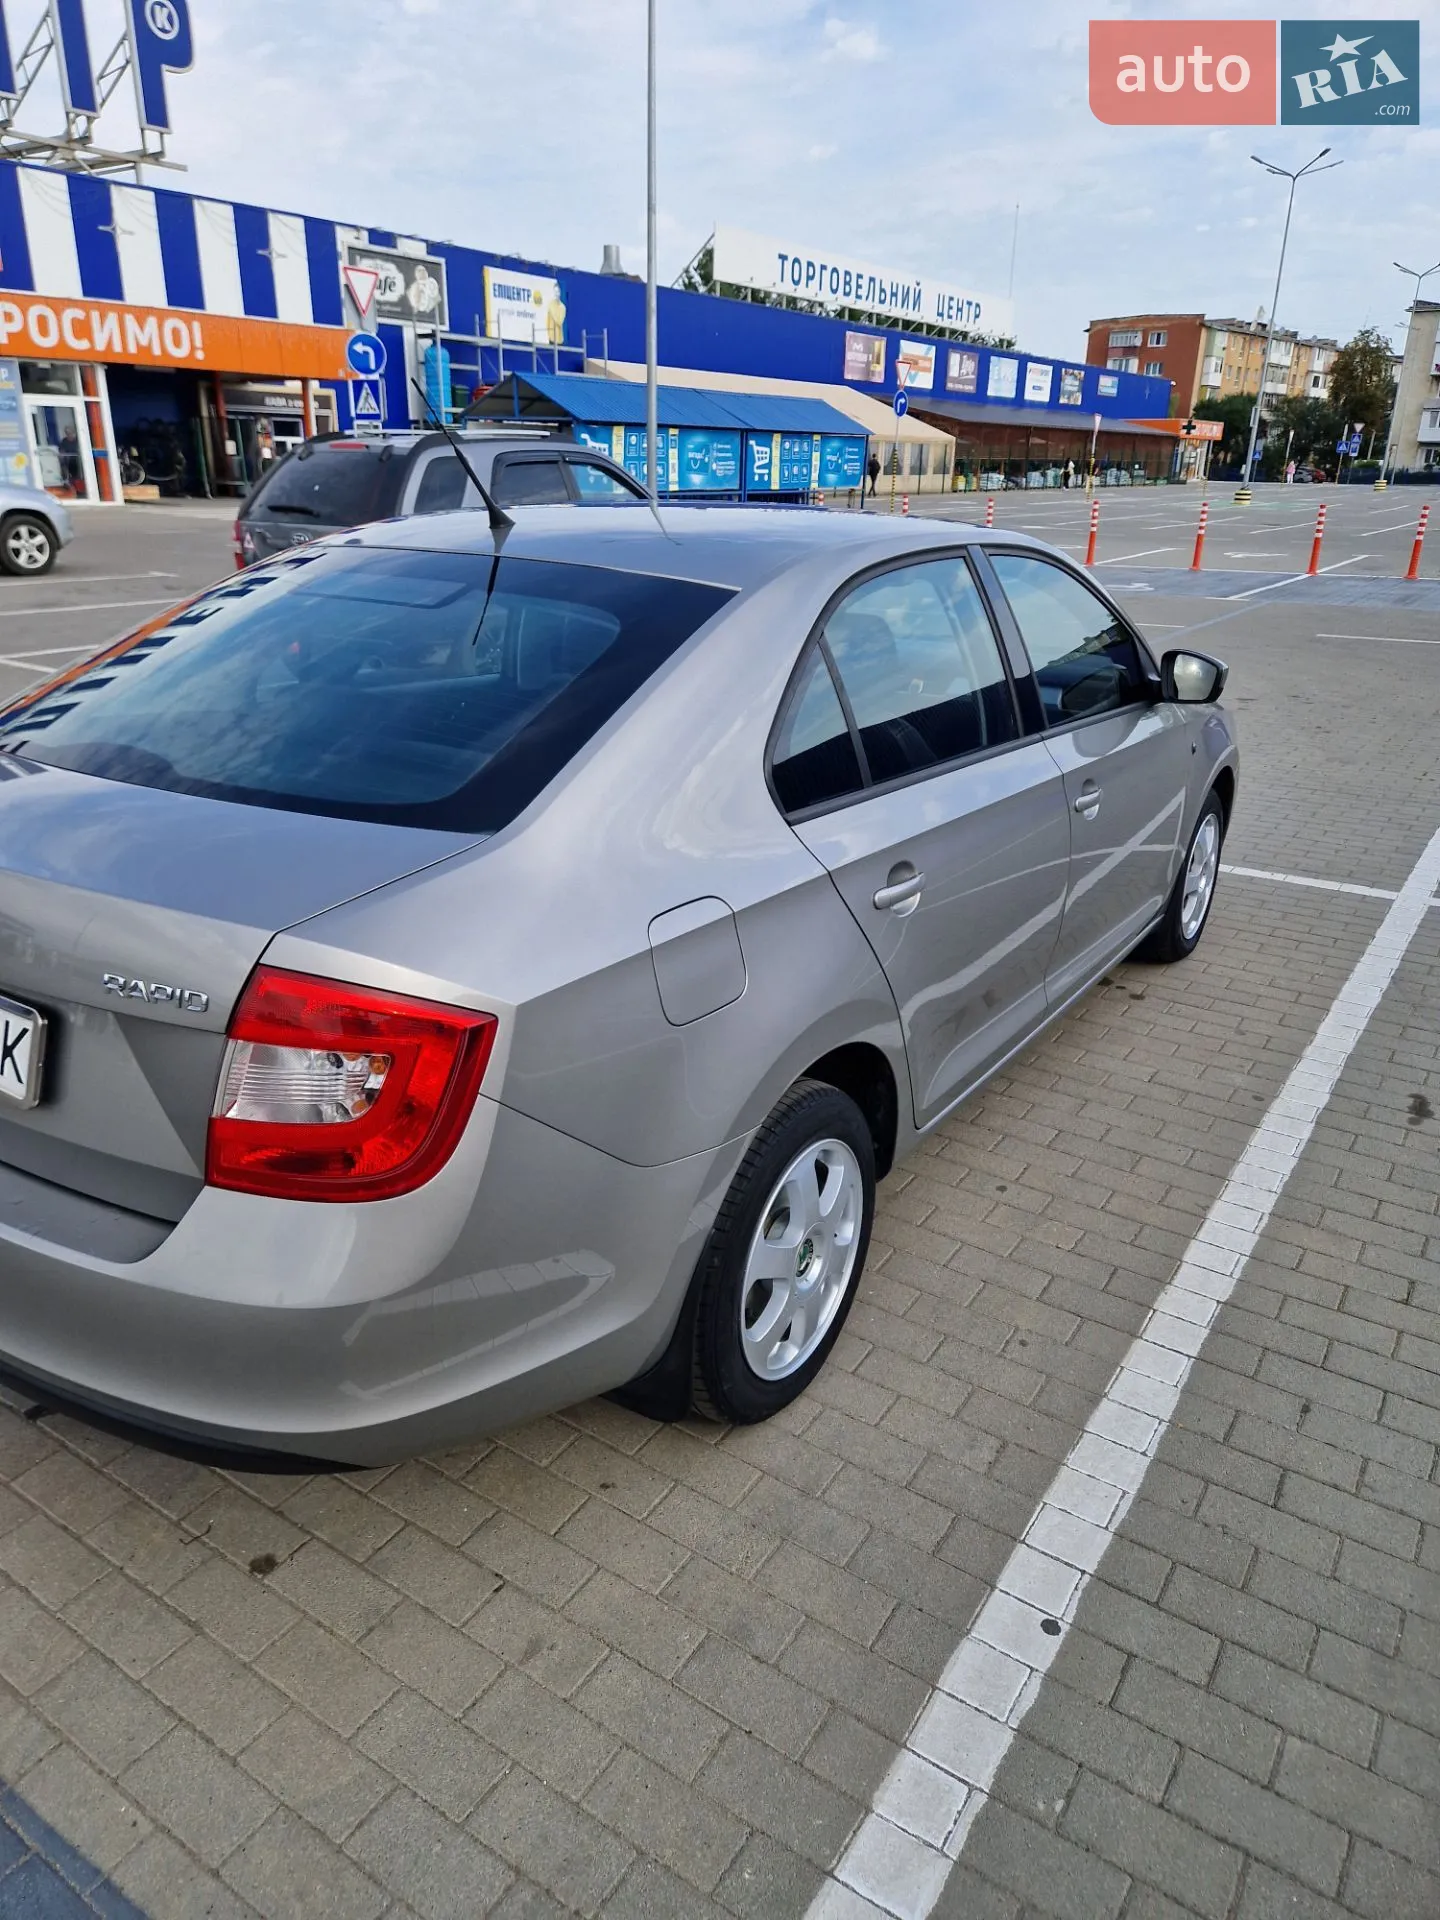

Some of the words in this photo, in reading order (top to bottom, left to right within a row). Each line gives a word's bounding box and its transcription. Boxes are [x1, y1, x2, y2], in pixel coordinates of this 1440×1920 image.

[493, 282, 532, 303] ЕПІЦЕНТР
[778, 253, 922, 313] ТОРГОВЕЛЬНИЙ
[937, 293, 981, 325] ЦЕНТР
[0, 302, 206, 360] РОСИМО!
[103, 973, 209, 1013] RAPID
